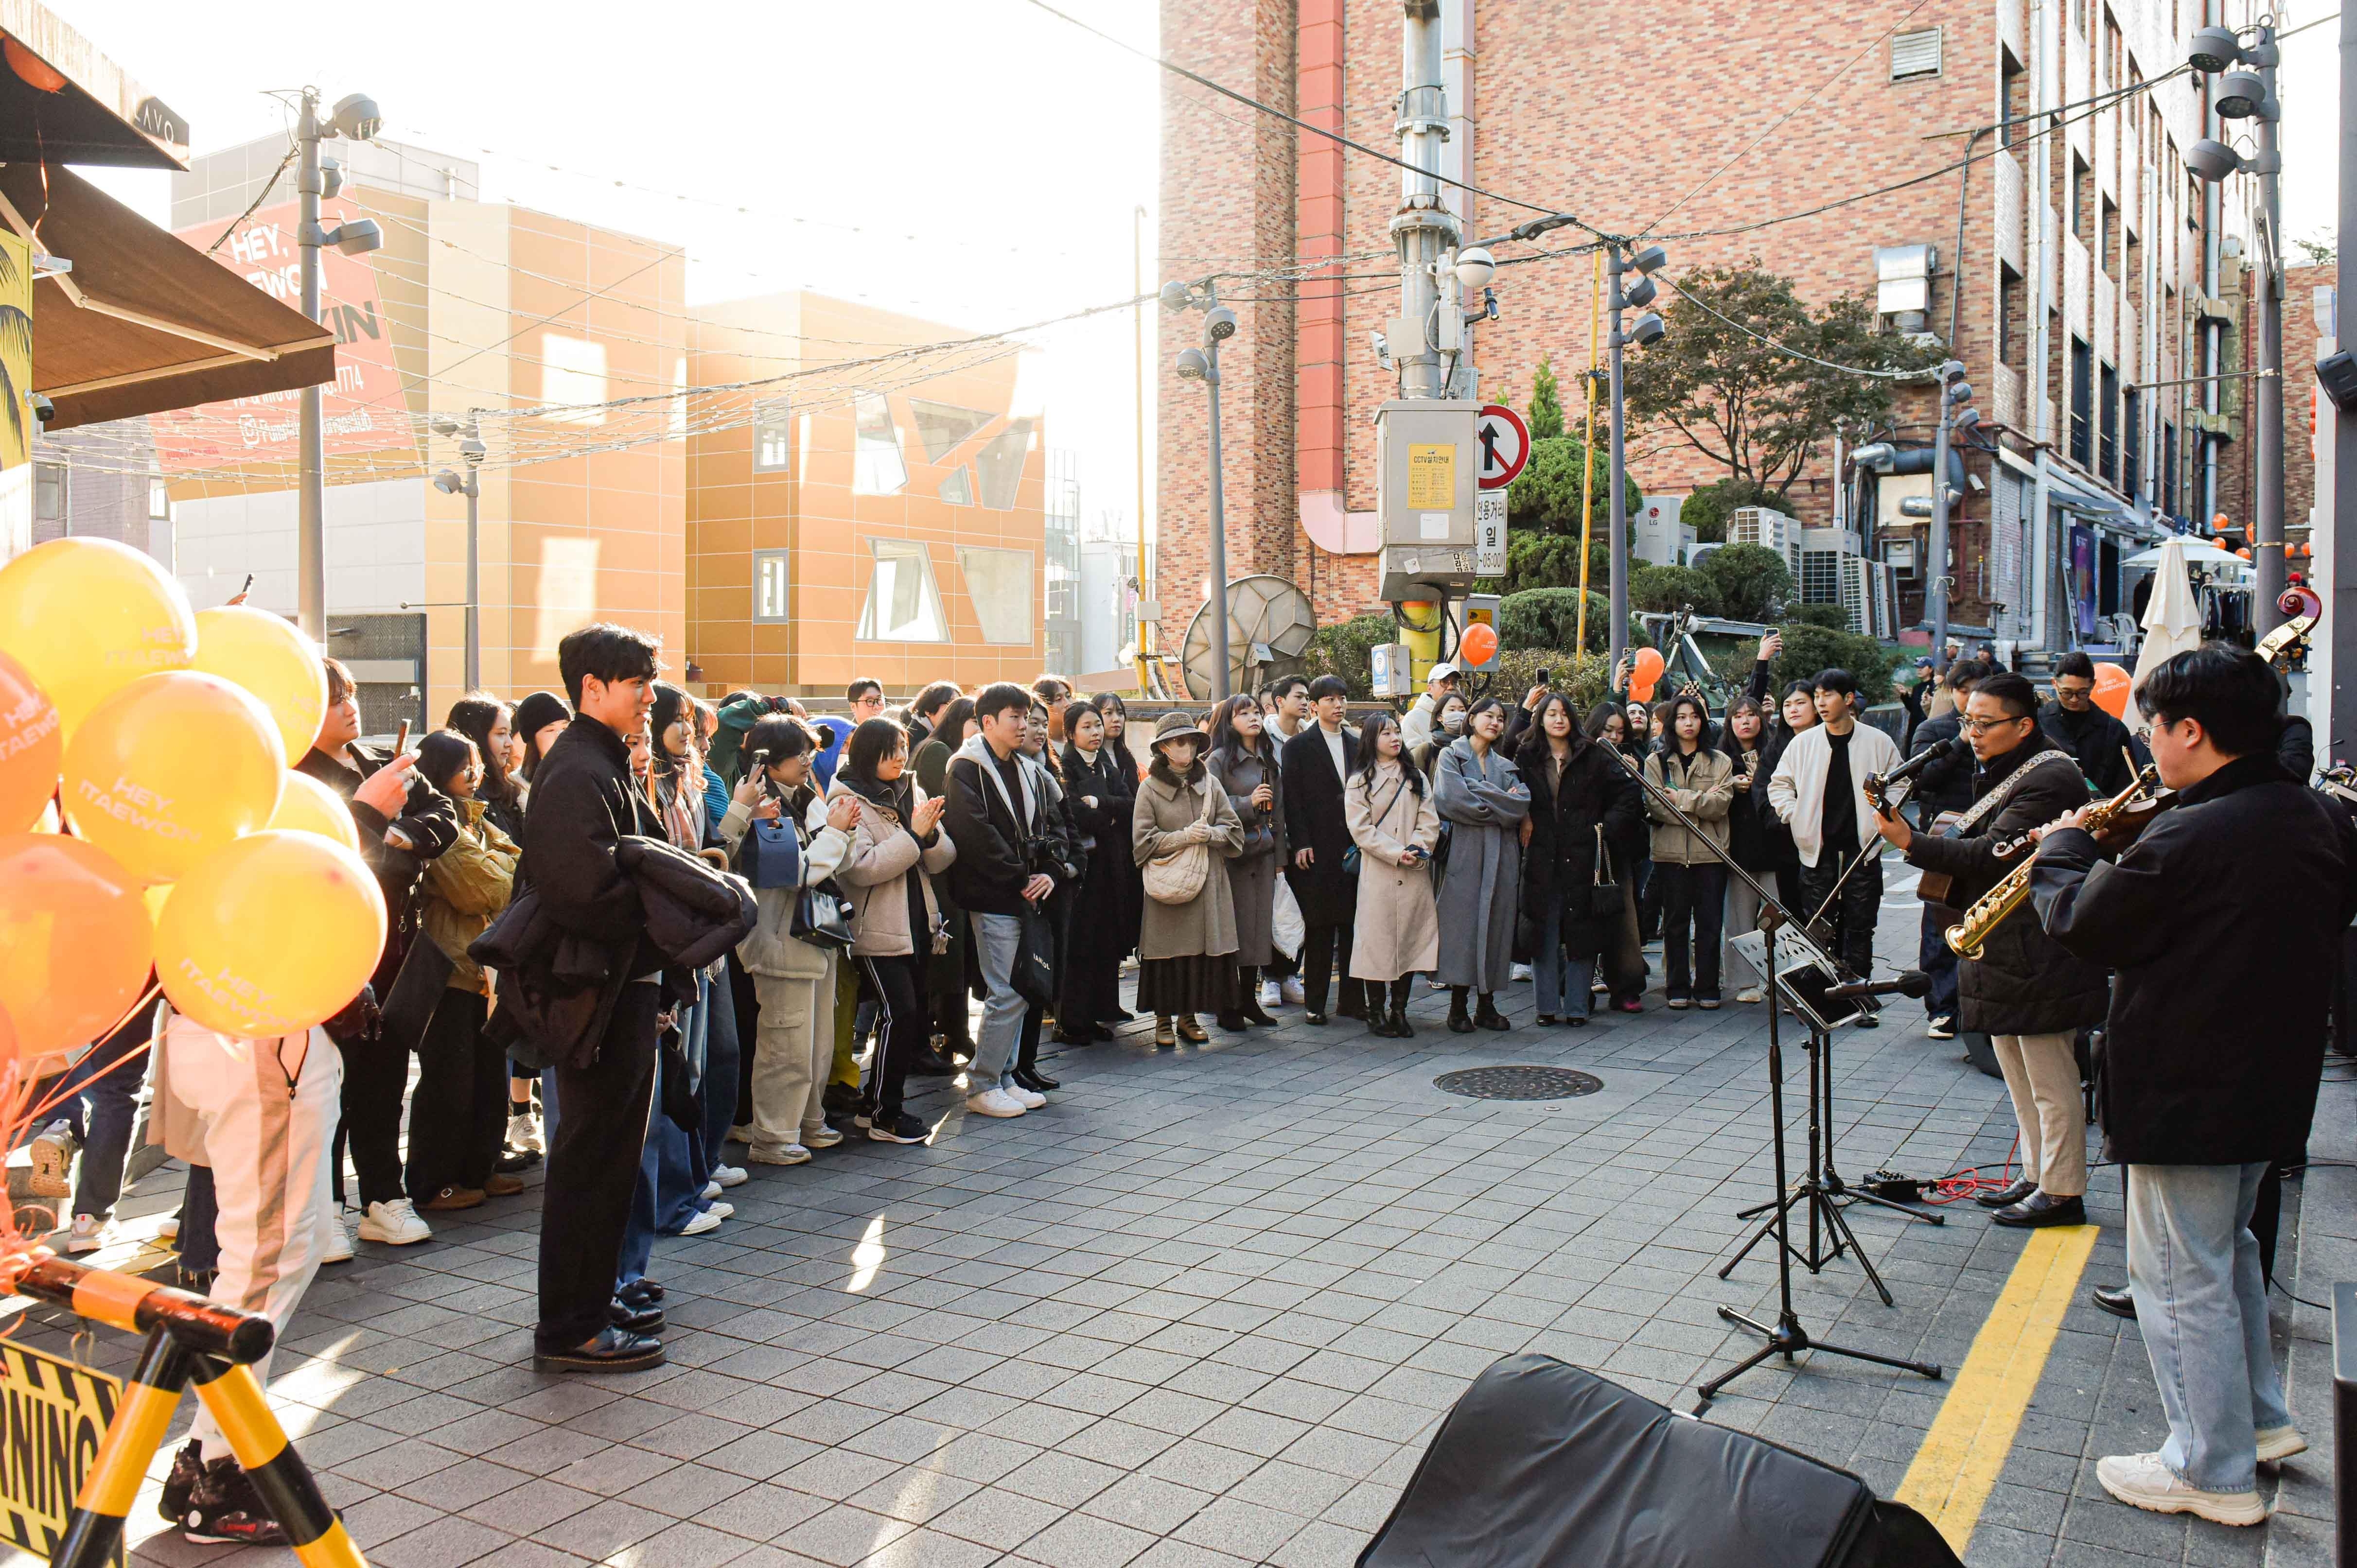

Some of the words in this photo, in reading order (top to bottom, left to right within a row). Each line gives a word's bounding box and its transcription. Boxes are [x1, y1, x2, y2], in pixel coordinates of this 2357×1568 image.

[229, 223, 288, 263] HEY,
[78, 779, 203, 844] ITAEWON
[179, 958, 299, 1028] ITAEWON
